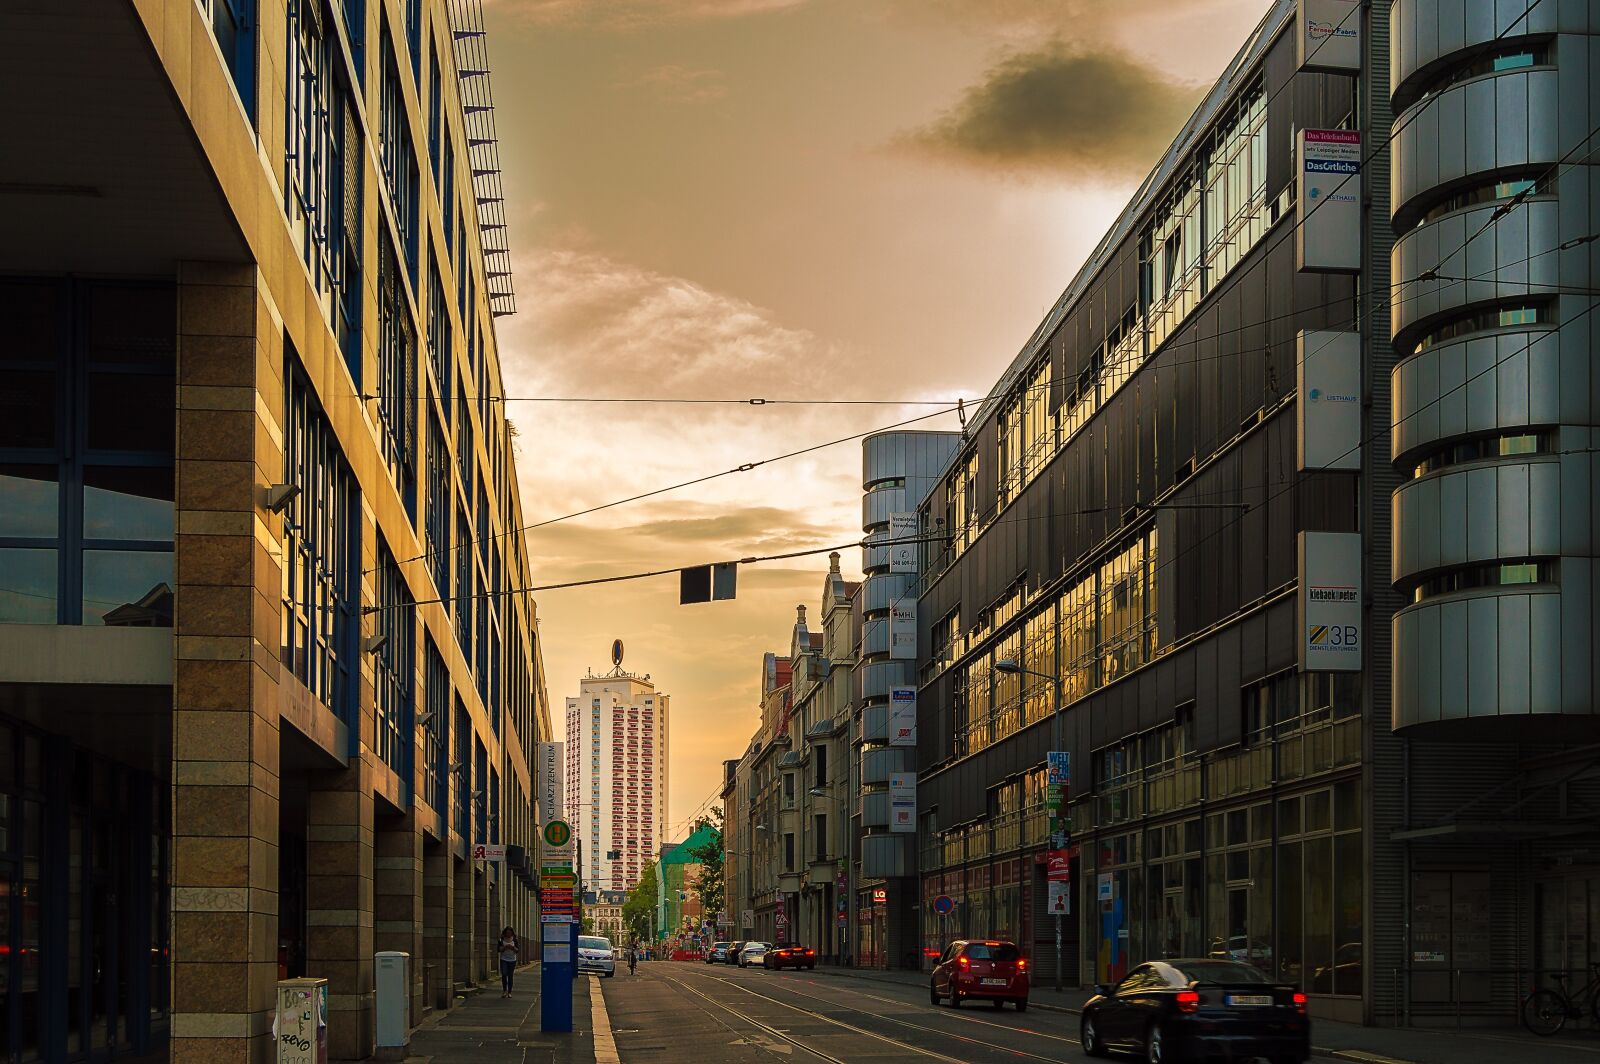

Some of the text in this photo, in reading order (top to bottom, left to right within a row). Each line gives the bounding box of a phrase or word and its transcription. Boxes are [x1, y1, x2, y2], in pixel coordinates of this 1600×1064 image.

[1307, 131, 1319, 140] Das
[898, 611, 915, 619] MHL
[1330, 625, 1358, 646] 3B
[547, 745, 556, 821] ACHARZTZENTRUM
